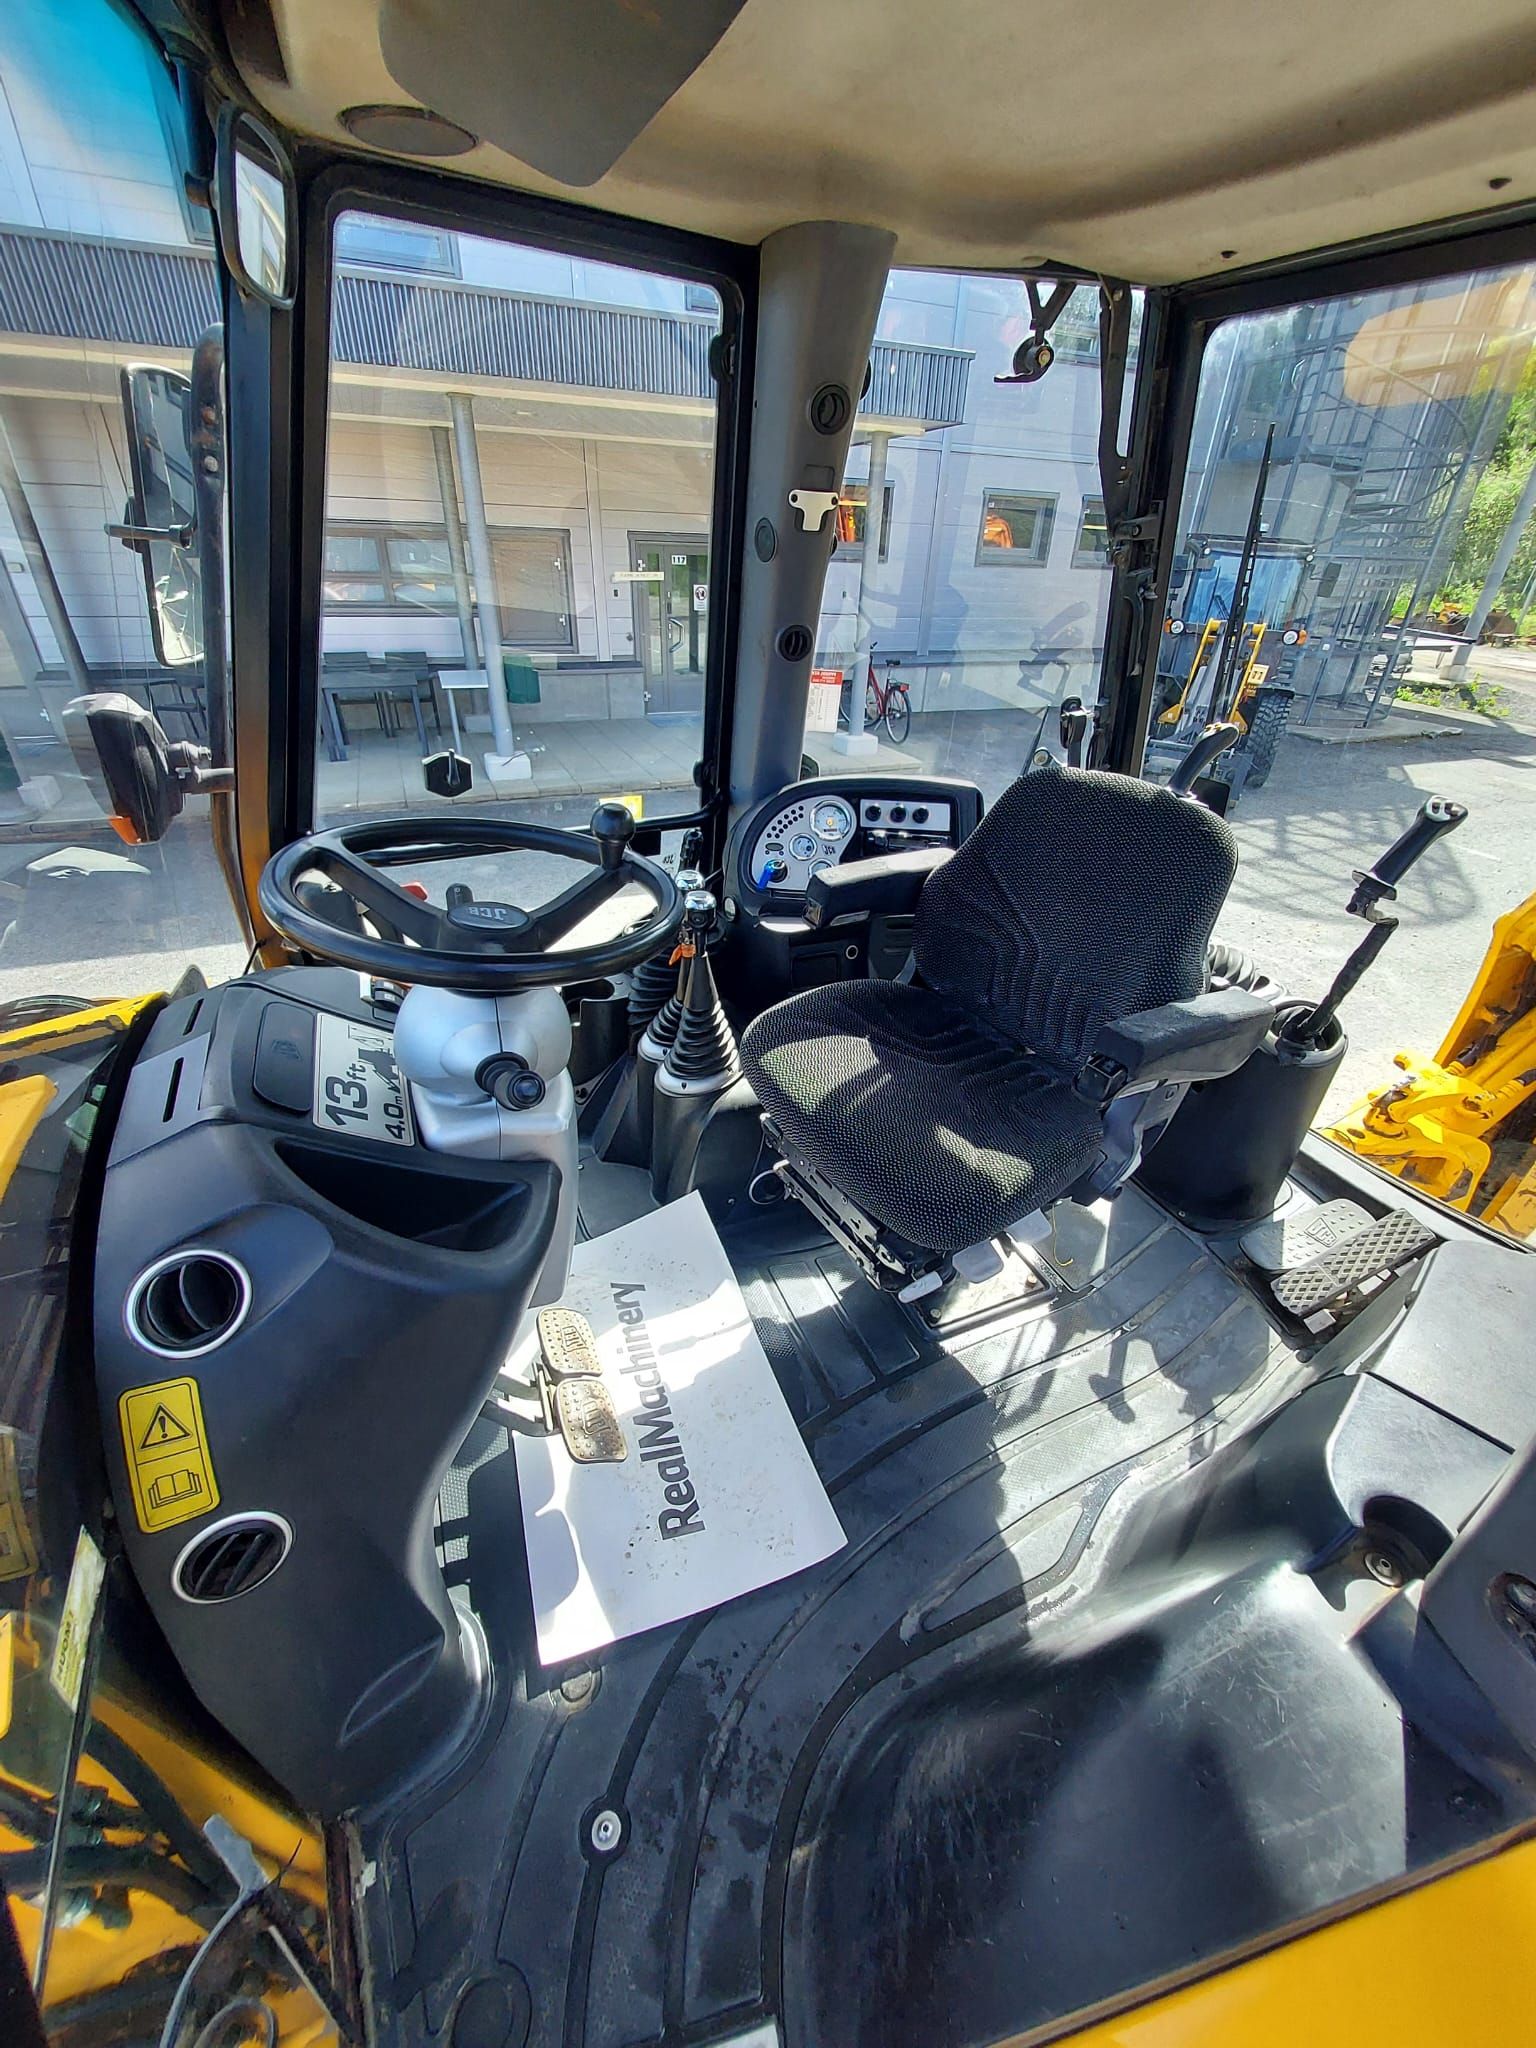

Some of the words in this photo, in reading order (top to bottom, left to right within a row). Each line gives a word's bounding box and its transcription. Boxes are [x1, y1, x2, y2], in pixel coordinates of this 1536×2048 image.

[672, 556, 686, 564] 117
[468, 906, 507, 920] JCB
[610, 1282, 706, 1541] RealMachinery
